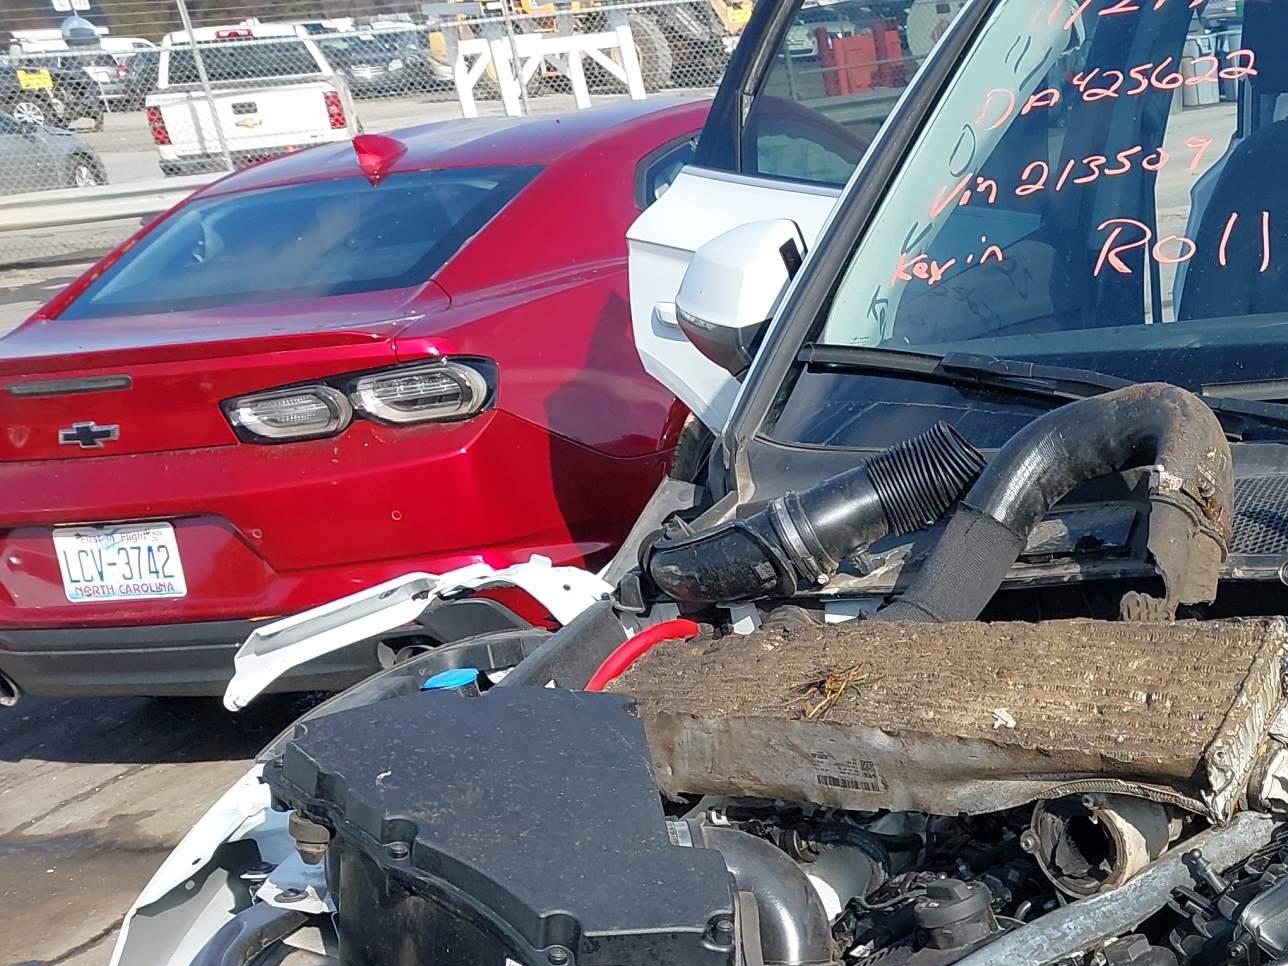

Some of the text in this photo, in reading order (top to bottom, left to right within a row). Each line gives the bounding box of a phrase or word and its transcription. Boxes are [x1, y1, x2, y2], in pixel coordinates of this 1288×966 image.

[63, 544, 175, 583] LCV-3742
[75, 581, 176, 597] NORTH CAROLINA
